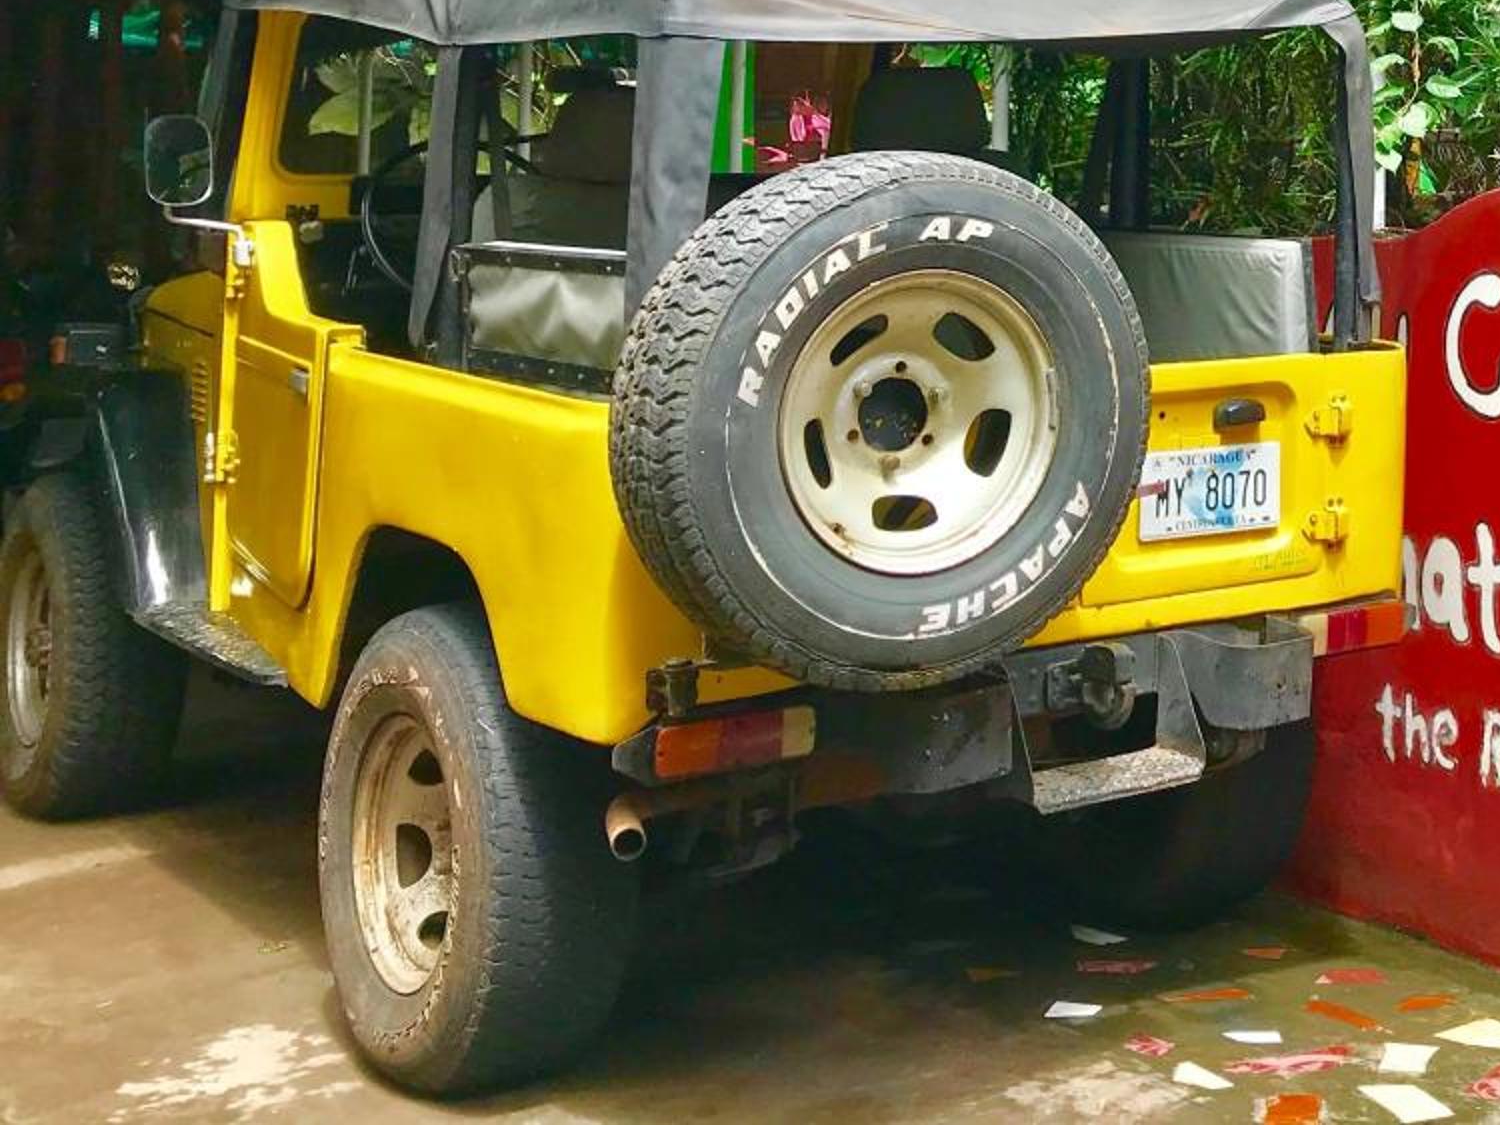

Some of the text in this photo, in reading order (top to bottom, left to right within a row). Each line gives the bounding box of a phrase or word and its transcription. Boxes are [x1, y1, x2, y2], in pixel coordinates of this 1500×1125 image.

[736, 216, 995, 408] RADIAL AP
[1205, 469, 1267, 511] 8070
[918, 481, 1092, 633] APACHE
[1375, 683, 1459, 769] the
